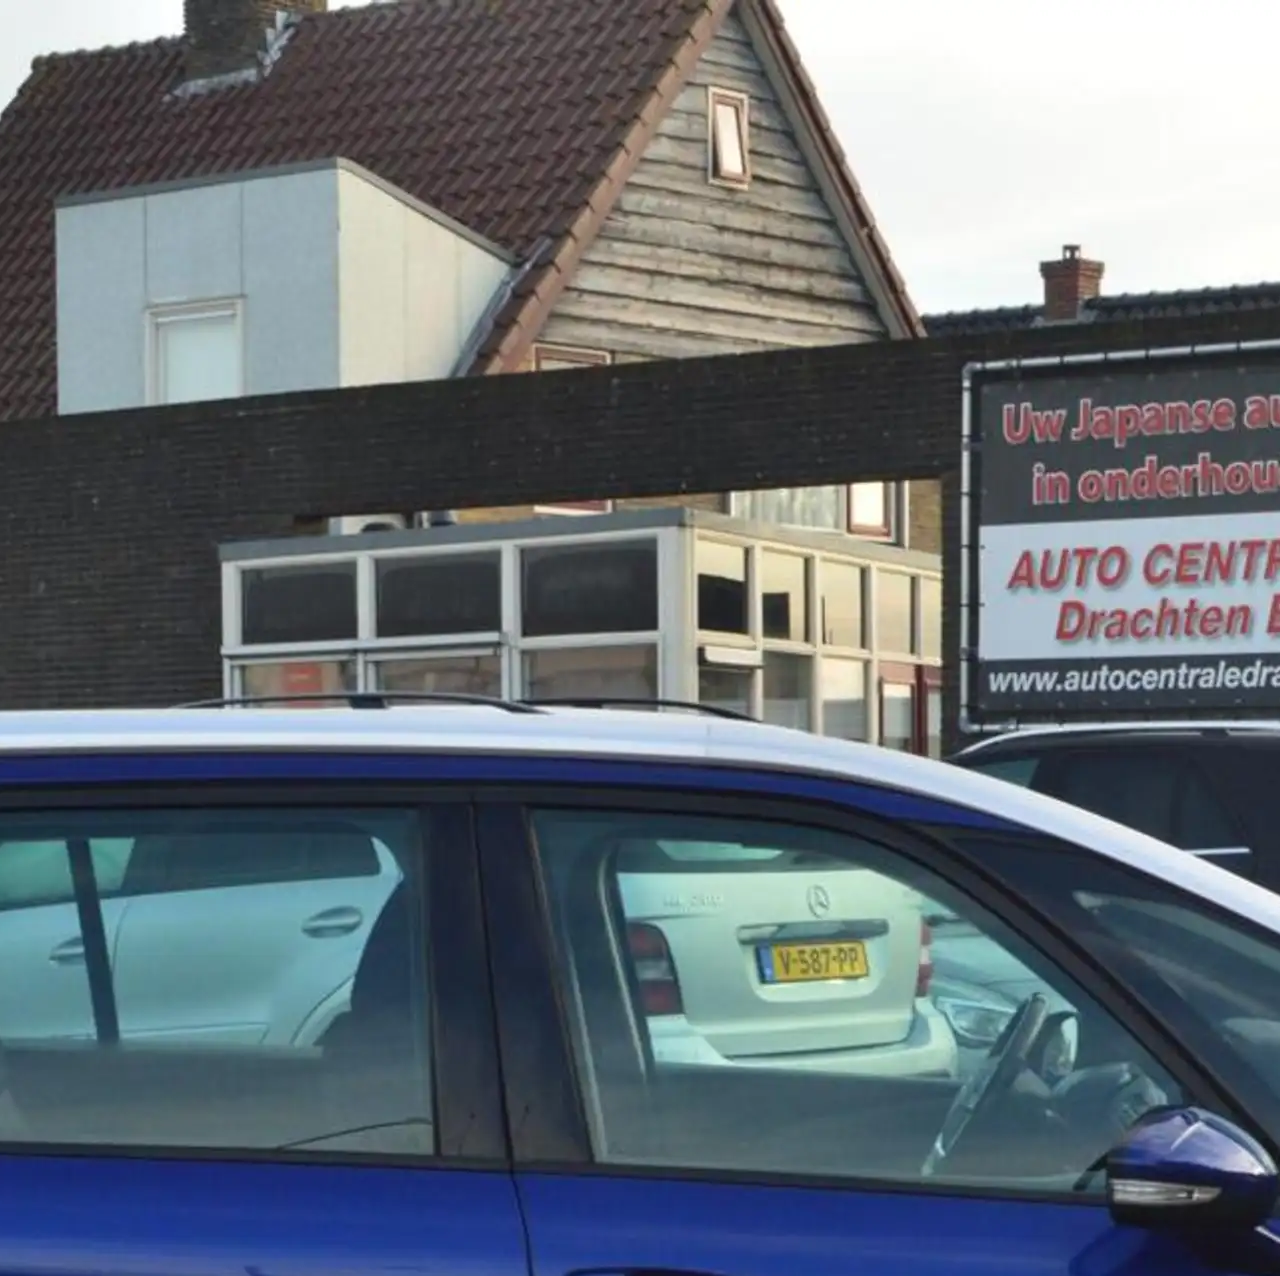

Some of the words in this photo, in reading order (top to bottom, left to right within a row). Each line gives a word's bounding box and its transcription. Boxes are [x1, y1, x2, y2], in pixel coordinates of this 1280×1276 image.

[1002, 402, 1066, 445] Uw
[1070, 397, 1235, 448] Japanse
[1032, 463, 1070, 506] in
[1007, 545, 1128, 591] AUTO
[1055, 597, 1251, 643] Drachten
[778, 947, 858, 976] V-587-PP
